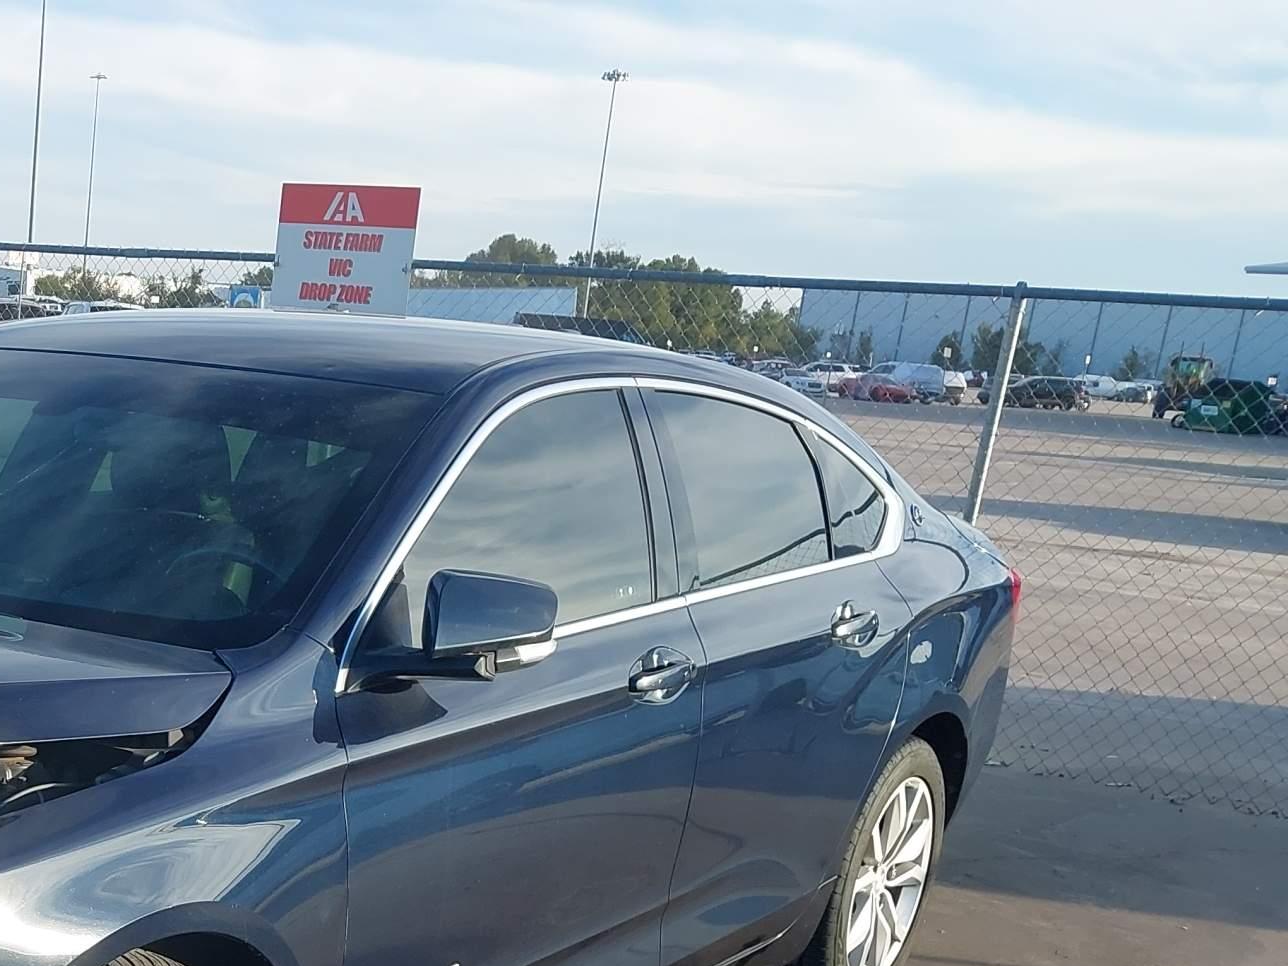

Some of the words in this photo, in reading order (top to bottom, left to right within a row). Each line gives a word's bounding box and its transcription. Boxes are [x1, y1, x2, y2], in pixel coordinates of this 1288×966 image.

[303, 230, 343, 250] STATE
[343, 233, 383, 252] FARM
[328, 258, 353, 277] VIC
[299, 282, 337, 302] DROP
[336, 284, 373, 304] ZONE
